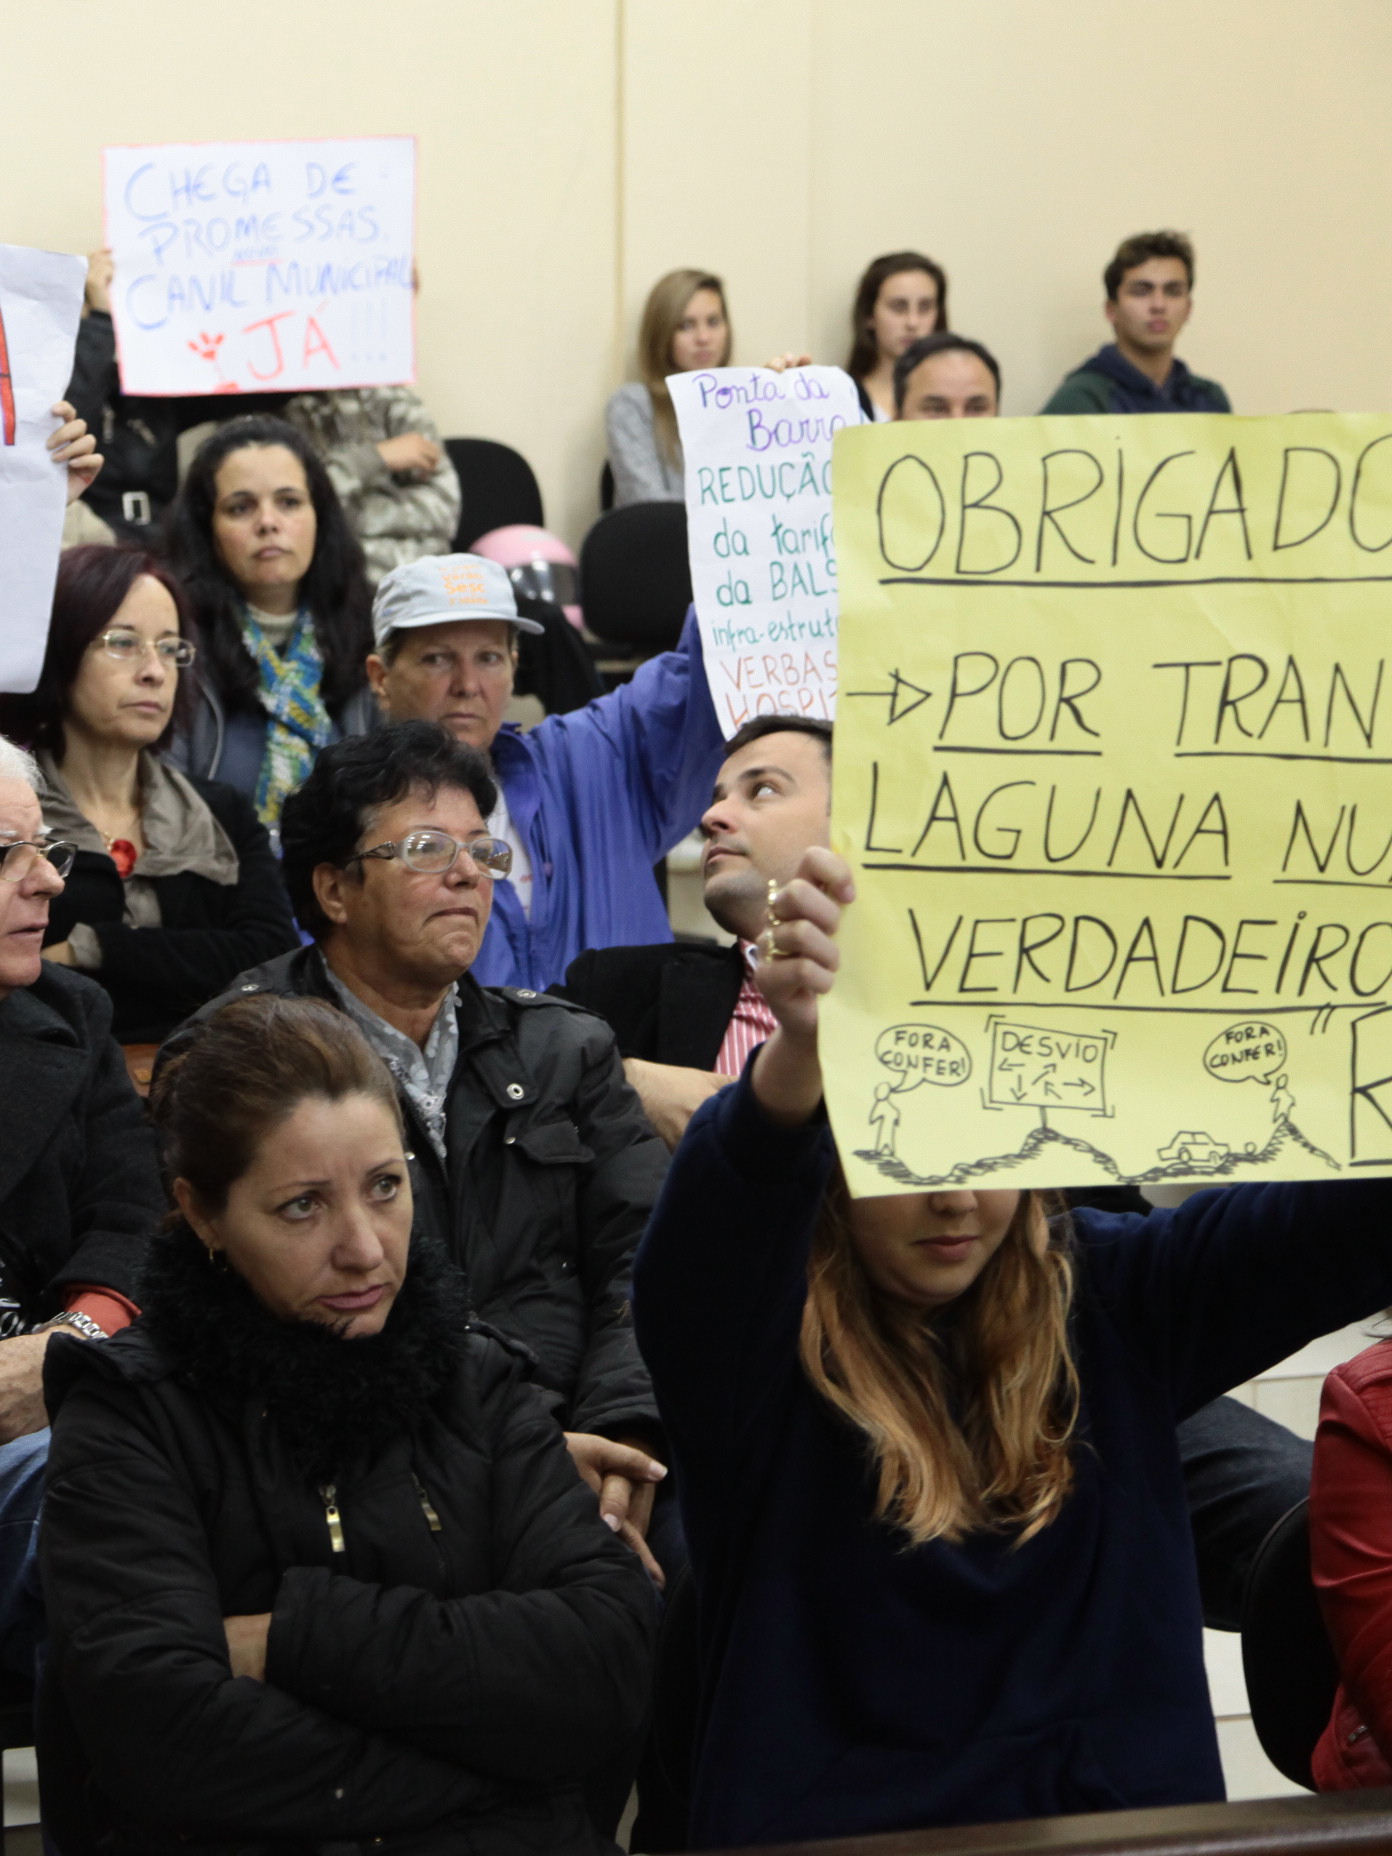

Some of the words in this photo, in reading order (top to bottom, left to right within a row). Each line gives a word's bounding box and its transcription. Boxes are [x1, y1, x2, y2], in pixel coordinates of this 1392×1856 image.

[124, 160, 273, 222] CHEGA
[305, 160, 359, 199] DE
[692, 372, 786, 409] Ponta
[793, 372, 830, 400] da
[713, 517, 750, 559] da
[771, 513, 834, 557] tarif
[716, 569, 753, 608] da
[711, 608, 839, 653] infra-estrut
[937, 651, 1103, 743] POR
[863, 761, 1231, 870] LAGUNA
[894, 1030, 951, 1053] FORA
[1001, 1031, 1100, 1064] DESVIO
[1224, 1025, 1271, 1045] FORA
